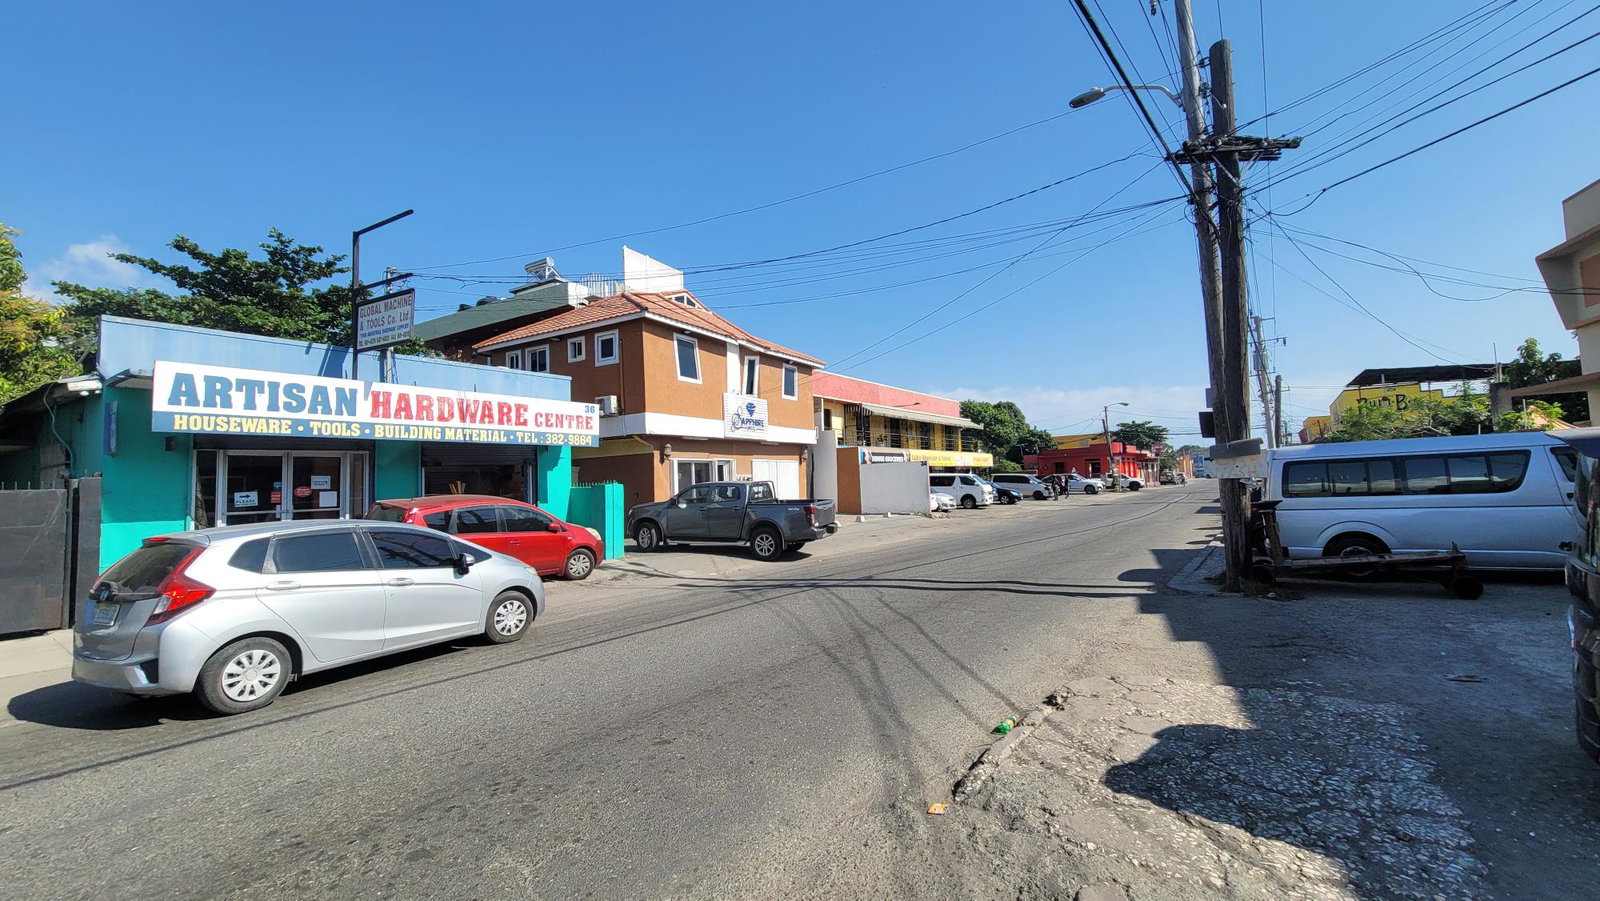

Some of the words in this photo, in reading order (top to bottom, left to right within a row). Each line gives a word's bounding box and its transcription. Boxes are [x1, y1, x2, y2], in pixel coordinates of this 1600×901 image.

[360, 304, 382, 319] GLOBAL
[384, 296, 412, 312] MACHINE
[366, 316, 385, 330] TOOLS
[387, 314, 398, 325] Co.
[167, 372, 358, 417] ARTISAN
[370, 391, 529, 427] HARDWARE
[534, 412, 593, 430] CENTRE
[584, 405, 595, 414] 36
[173, 414, 292, 434] HOUSEWARE
[309, 421, 361, 437] TOOLS
[374, 424, 441, 440] BUILDING
[444, 427, 507, 443] MATERIAL
